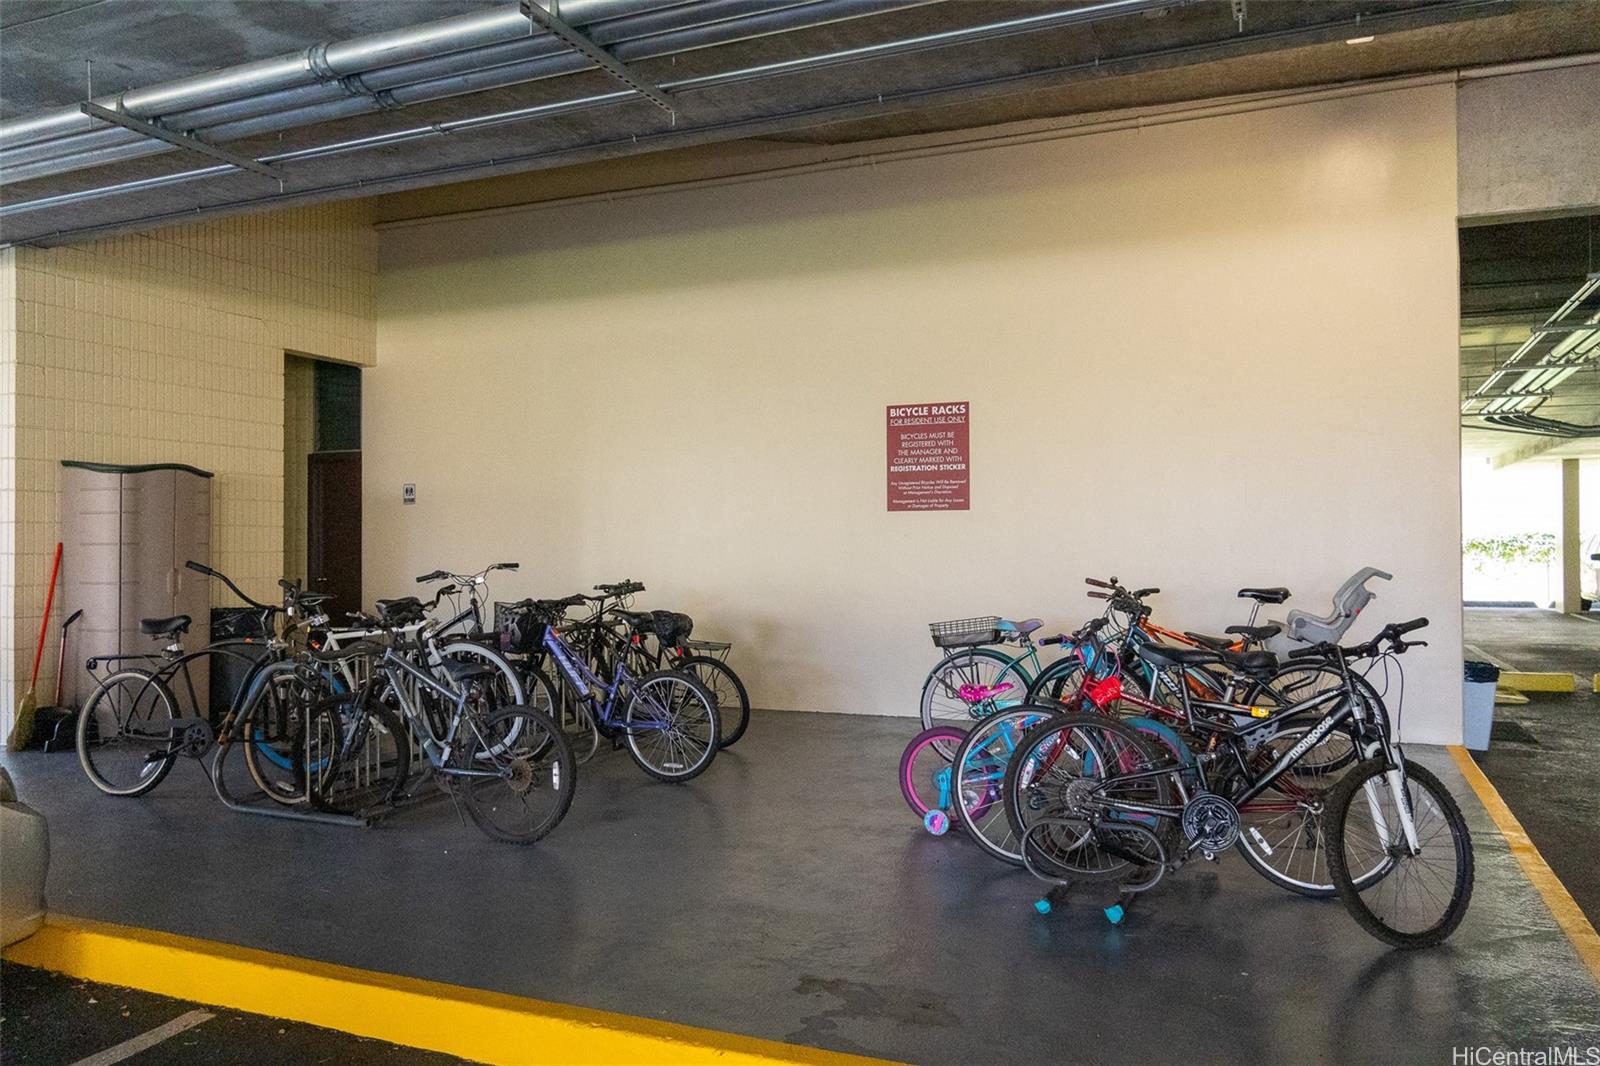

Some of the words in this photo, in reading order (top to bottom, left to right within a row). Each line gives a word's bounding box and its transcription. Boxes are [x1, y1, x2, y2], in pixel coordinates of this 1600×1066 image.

[890, 407, 928, 416] BICYCLE
[932, 405, 966, 415] RACKS
[1290, 716, 1334, 759] mongoose
